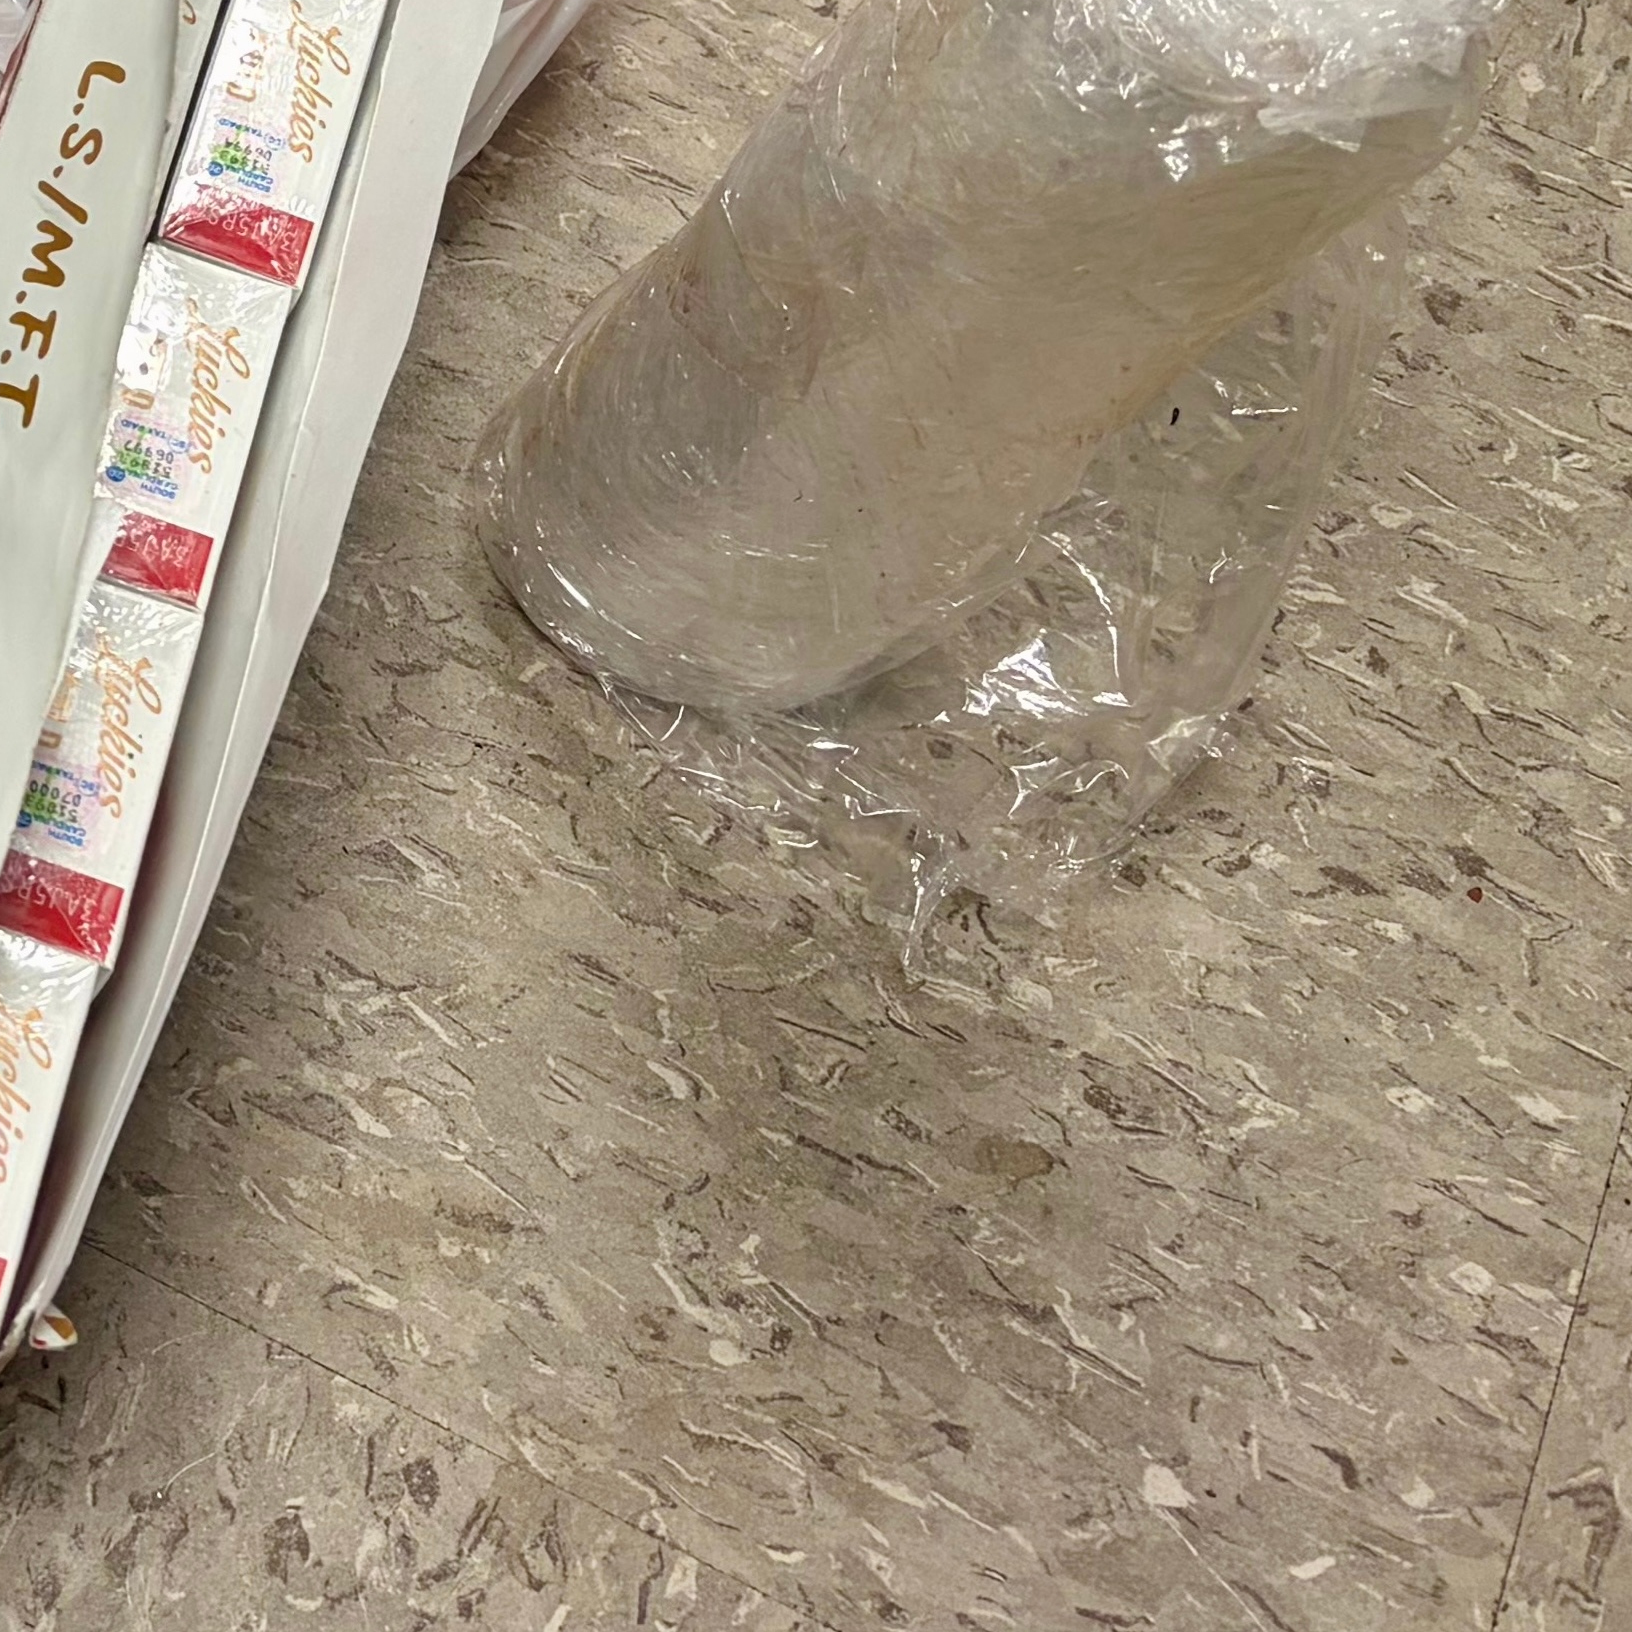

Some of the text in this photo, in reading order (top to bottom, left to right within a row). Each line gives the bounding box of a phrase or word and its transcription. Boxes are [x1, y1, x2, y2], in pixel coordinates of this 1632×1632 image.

[287, 0, 352, 164] Luckies
[236, 176, 272, 193] SOUTH
[181, 296, 251, 477] Luckies
[139, 482, 176, 499] SOUTH
[90, 630, 164, 821] Luckies
[45, 827, 85, 847] SOUTH
